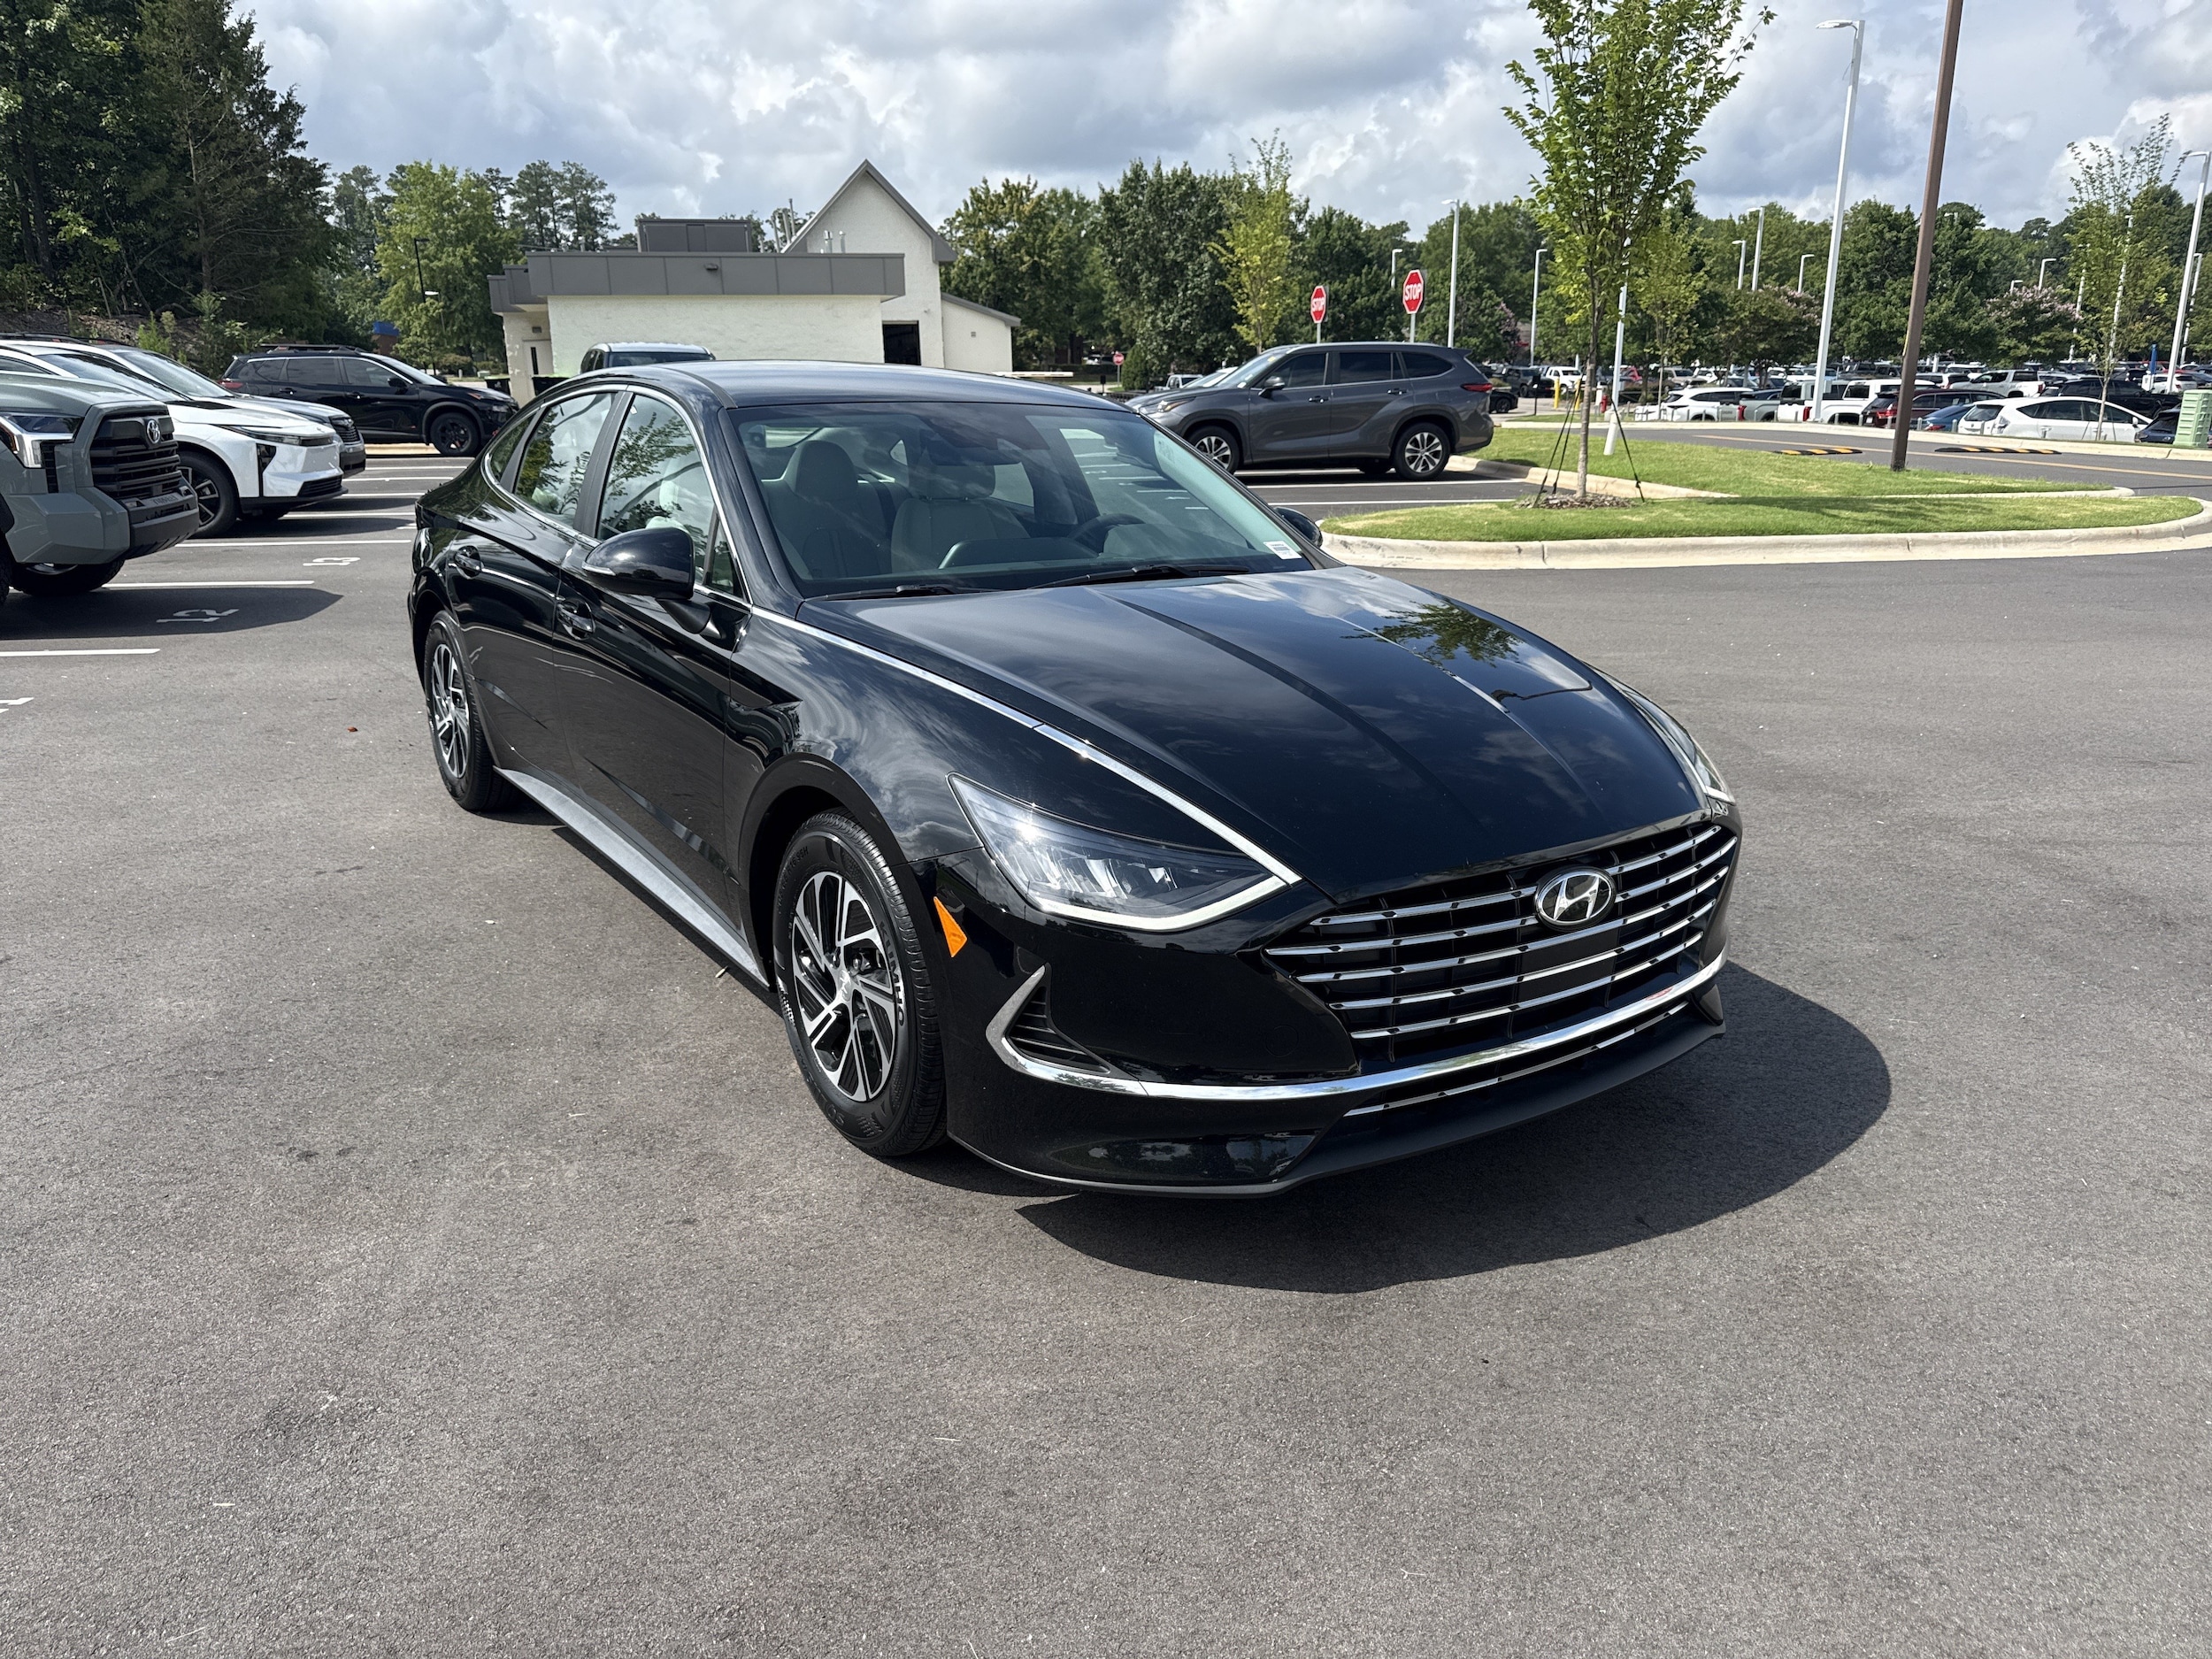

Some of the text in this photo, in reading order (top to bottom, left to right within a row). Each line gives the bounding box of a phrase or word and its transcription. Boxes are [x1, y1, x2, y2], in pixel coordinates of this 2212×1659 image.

[1404, 283, 1423, 301] STOP
[1311, 298, 1325, 311] STOP
[879, 921, 905, 1026] KUMHO
